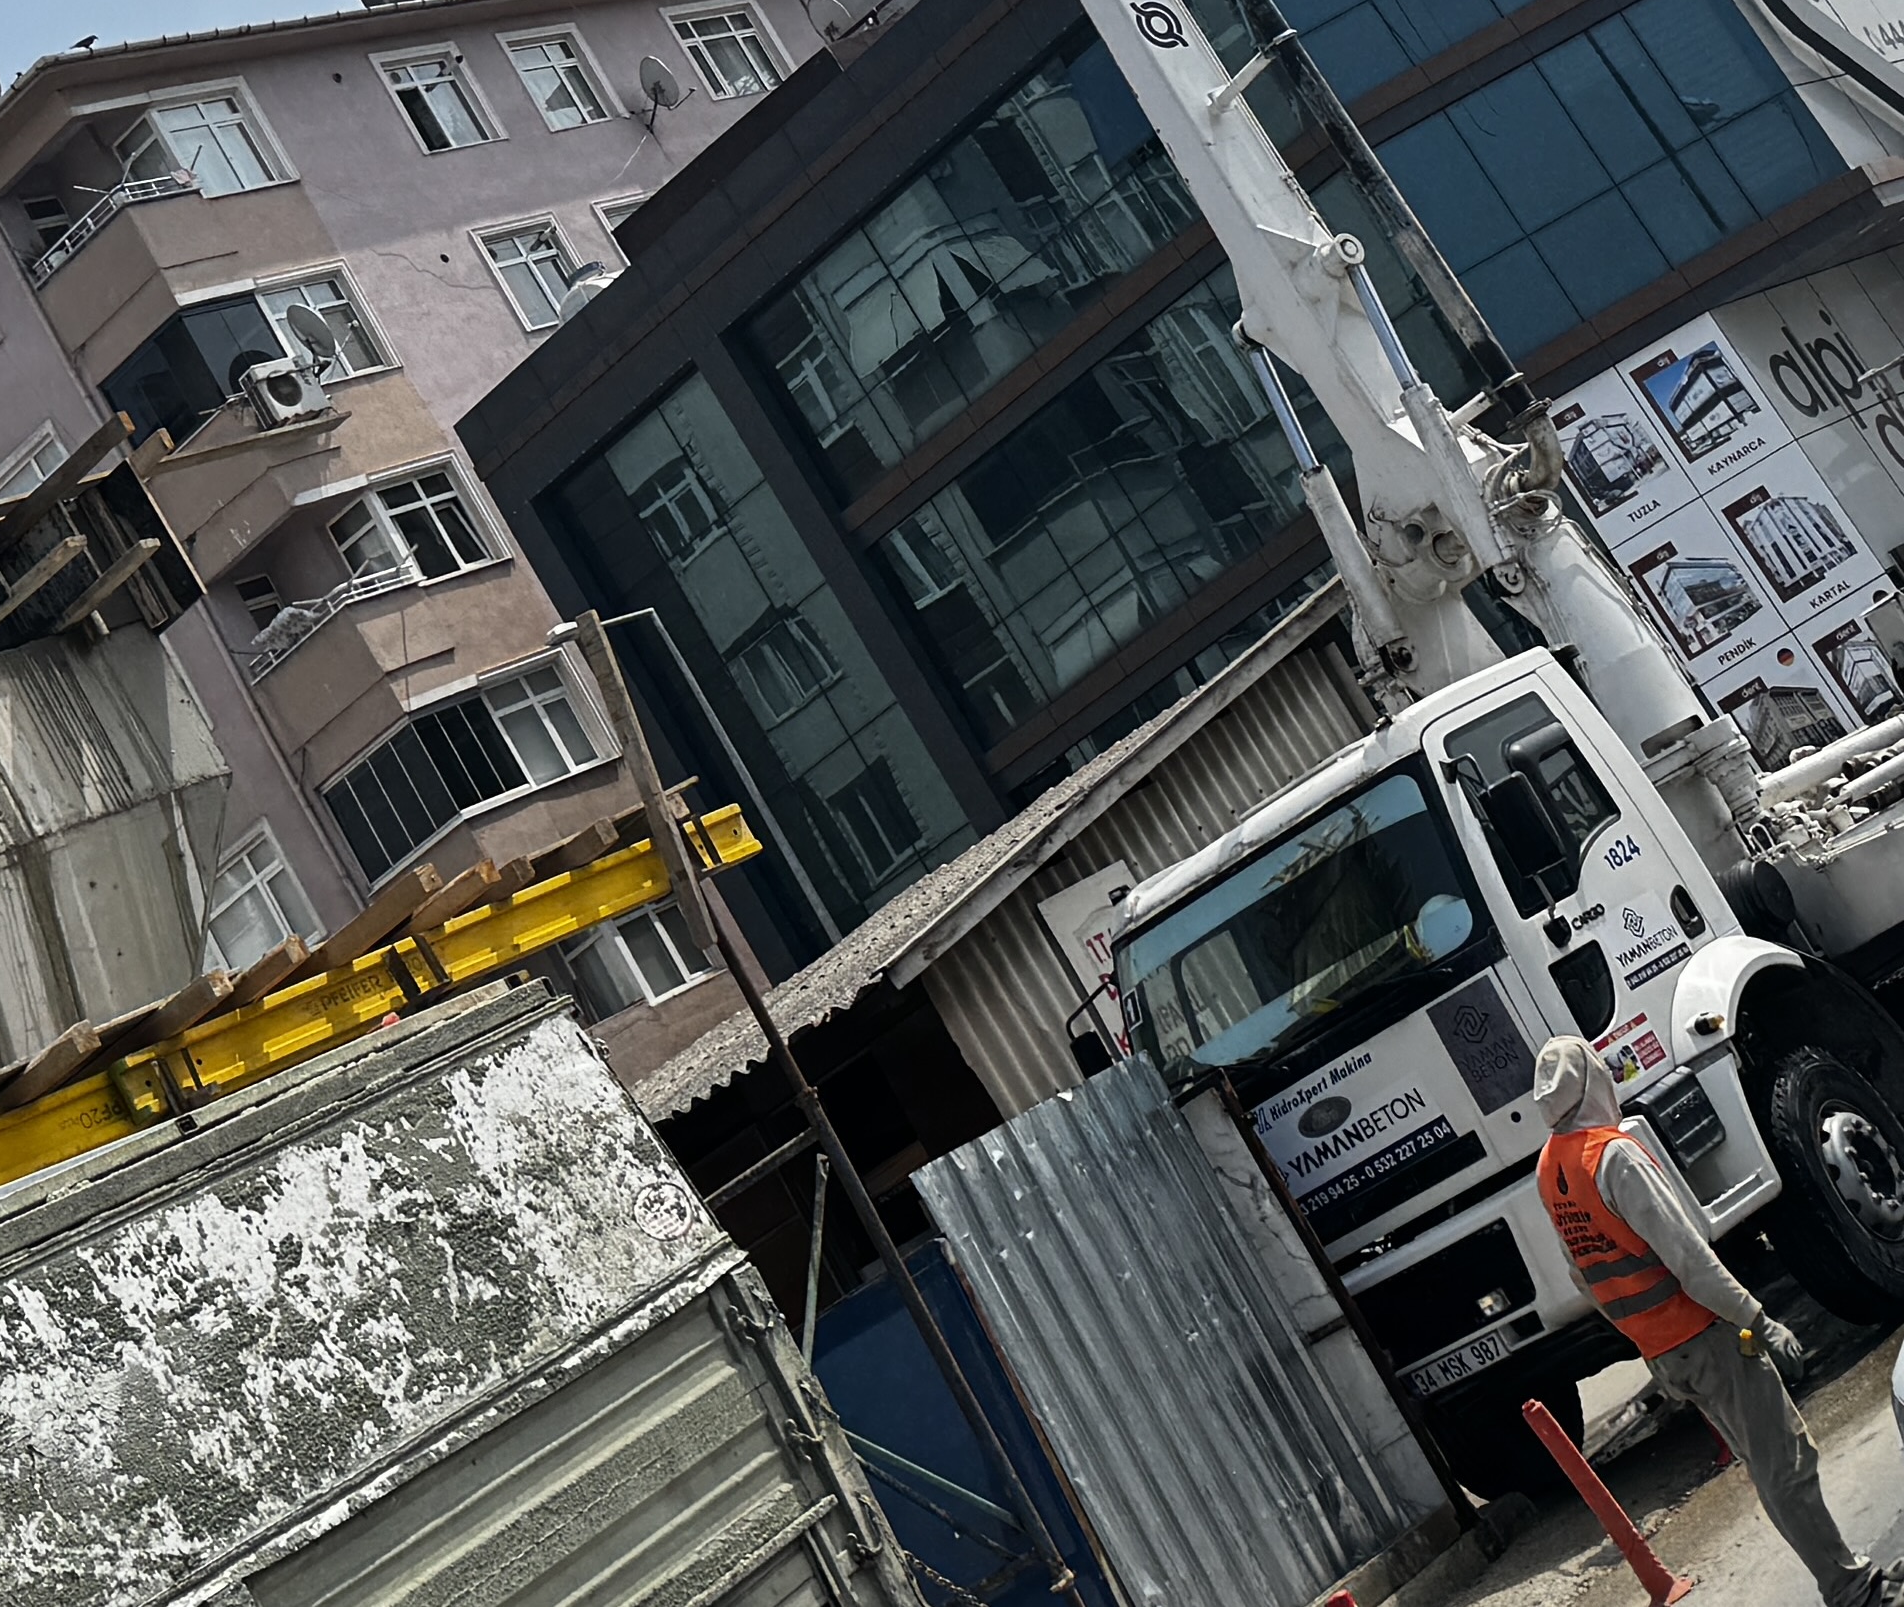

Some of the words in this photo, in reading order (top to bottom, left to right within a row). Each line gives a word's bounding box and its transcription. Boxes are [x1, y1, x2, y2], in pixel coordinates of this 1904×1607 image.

[1769, 309, 1878, 430] alpi
[1707, 437, 1767, 476] KAYNARCA
[1626, 499, 1662, 524] TUZLA
[1808, 580, 1851, 609] KARTAL
[1717, 637, 1757, 666] PENDİK
[1603, 834, 1642, 871] 1824
[1615, 924, 1679, 968] YAMANBETON
[321, 975, 382, 1010] PFEIFER
[1269, 1077, 1328, 1122] HidroXport
[1330, 1052, 1372, 1086] Makina
[1287, 1087, 1426, 1178] YAMANBETON
[1308, 1191, 1330, 1213] 219
[1327, 1182, 1345, 1201] 94
[1342, 1173, 1361, 1191] 25
[1364, 1165, 1376, 1179] 0
[1374, 1154, 1398, 1174] 532
[1395, 1141, 1418, 1162] 227
[1416, 1131, 1435, 1149] 25
[1433, 1120, 1452, 1140] 04
[1414, 1369, 1438, 1393] 34
[1437, 1352, 1472, 1382] MSK
[1470, 1336, 1500, 1365] 987
